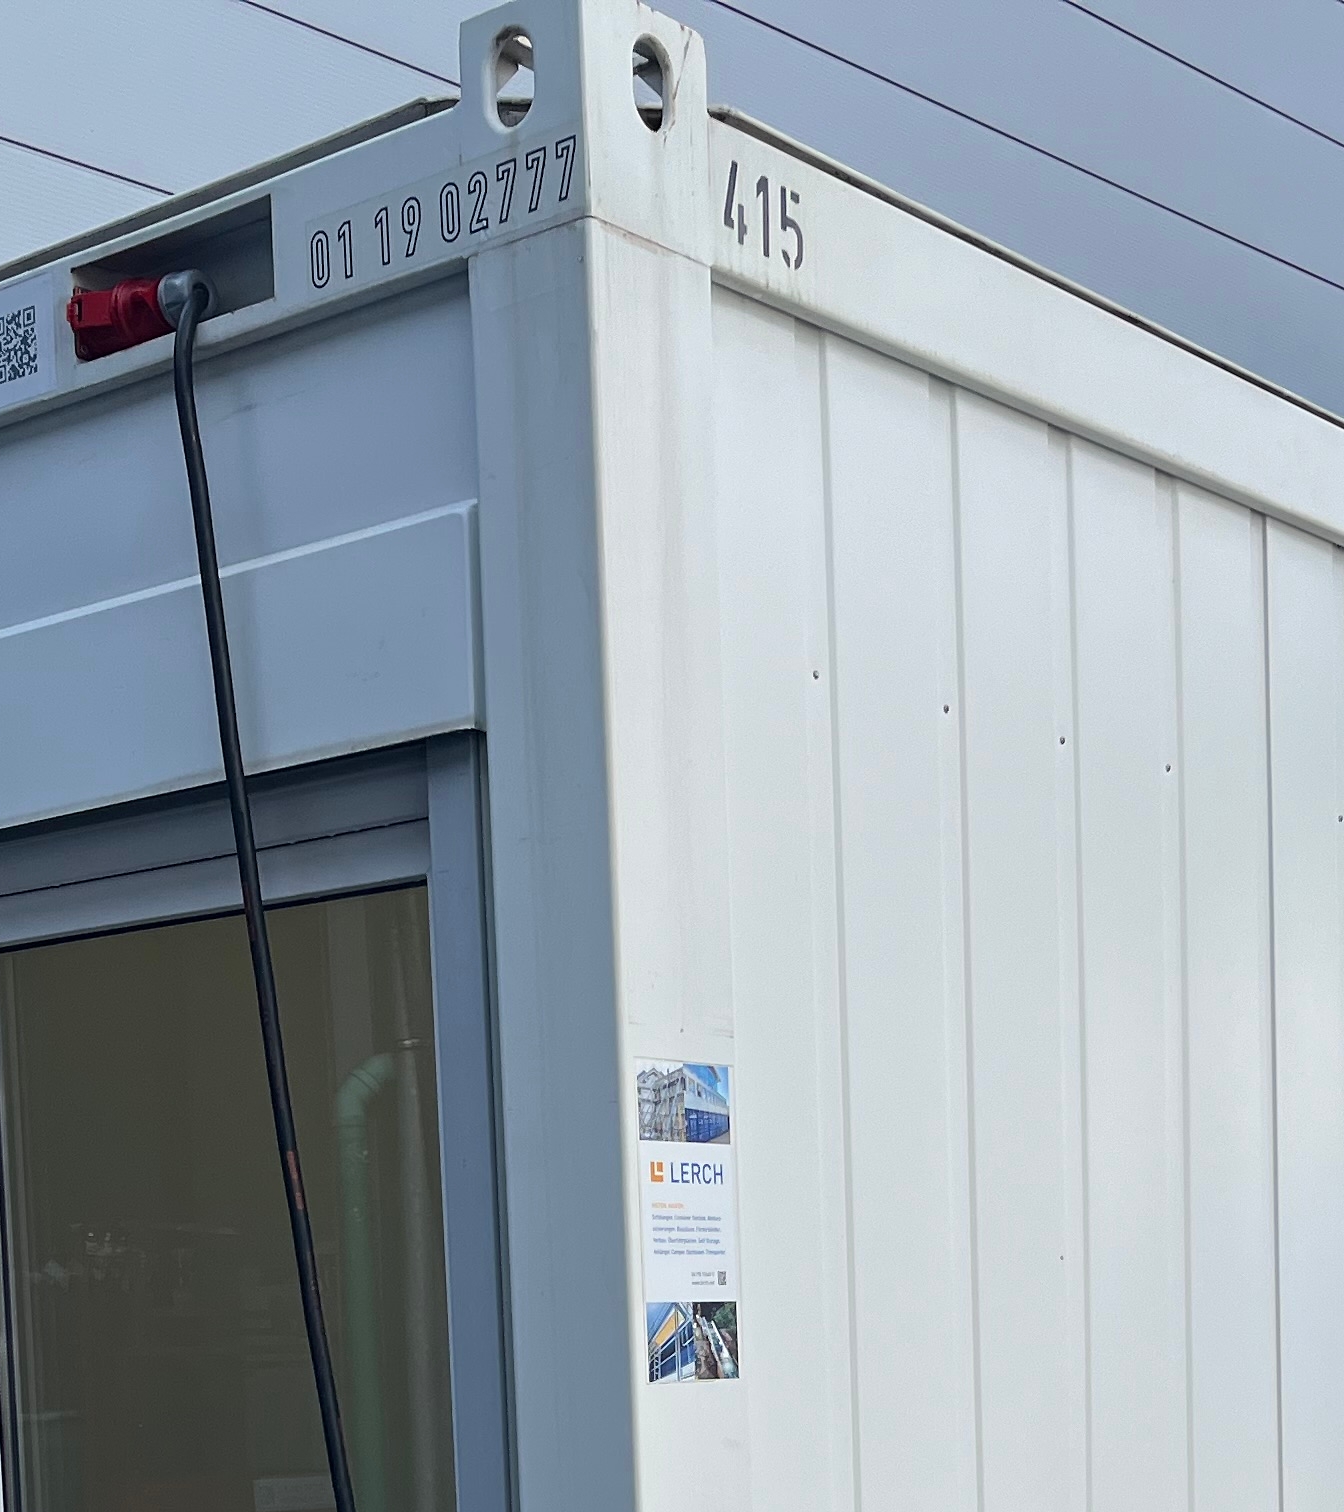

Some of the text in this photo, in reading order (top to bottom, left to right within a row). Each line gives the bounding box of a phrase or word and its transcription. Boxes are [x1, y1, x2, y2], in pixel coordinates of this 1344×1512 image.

[310, 135, 577, 288] 01 19 02777
[724, 160, 803, 270] 415
[670, 1161, 723, 1185] LERCH
